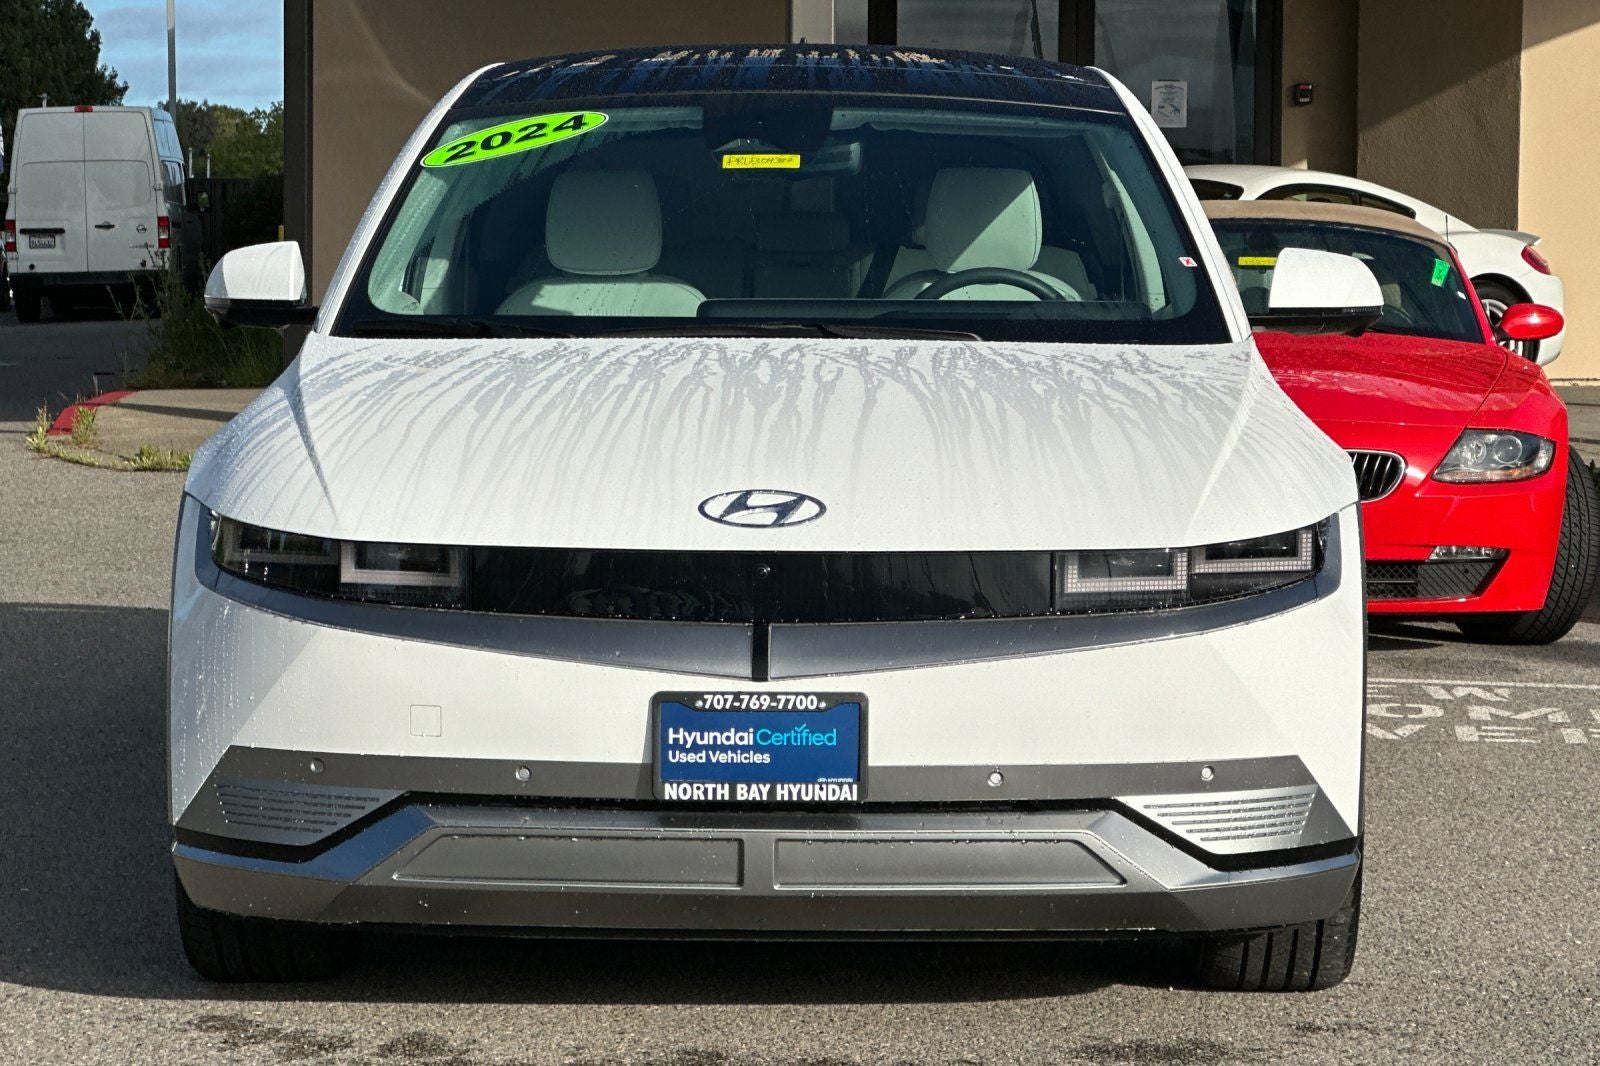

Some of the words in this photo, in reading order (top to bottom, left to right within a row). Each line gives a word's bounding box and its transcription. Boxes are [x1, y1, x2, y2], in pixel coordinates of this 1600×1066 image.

[443, 114, 587, 163] 2024
[703, 694, 818, 710] 707-769-7700
[668, 727, 754, 749] Hyundai
[756, 723, 837, 746] Certified
[668, 750, 706, 763] Used
[708, 750, 771, 764] Vehicles
[664, 783, 730, 801] NORTH
[736, 783, 770, 801] BAY
[776, 783, 858, 801] HYUNDAI
